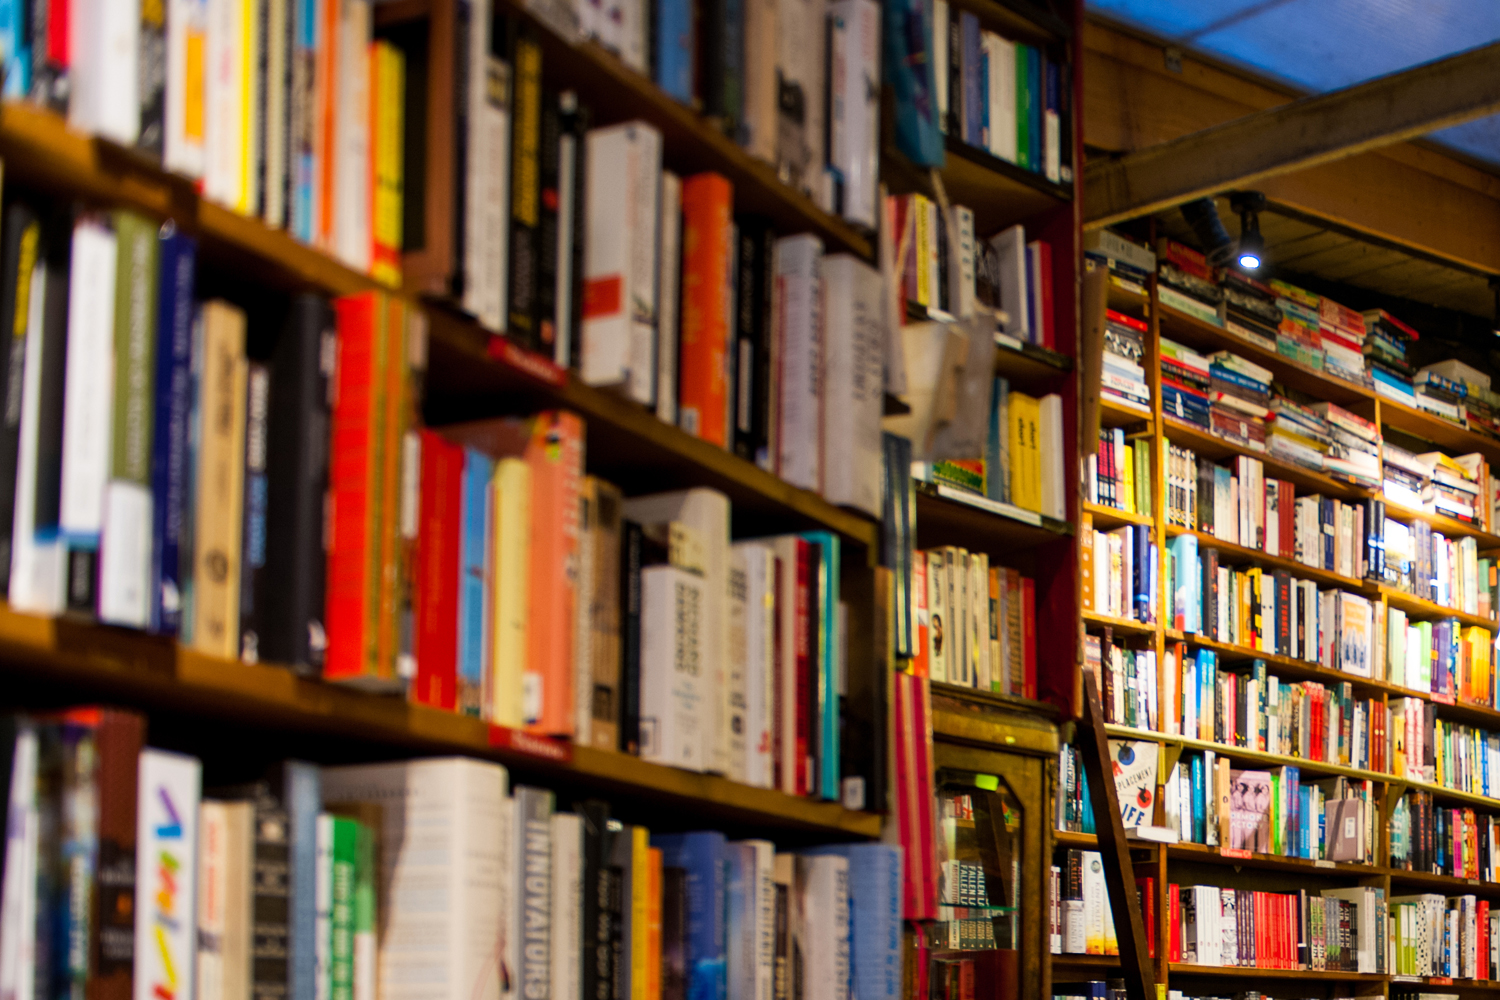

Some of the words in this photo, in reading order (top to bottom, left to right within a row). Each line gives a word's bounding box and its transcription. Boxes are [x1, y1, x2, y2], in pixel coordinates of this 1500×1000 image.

[1281, 584, 1289, 600] THE
[1281, 601, 1289, 638] TUNNEL
[960, 865, 968, 897] FALLEN
[969, 865, 977, 897] FALLEN
[977, 865, 985, 897] FALLEN
[524, 820, 554, 1000] INNOVATORS
